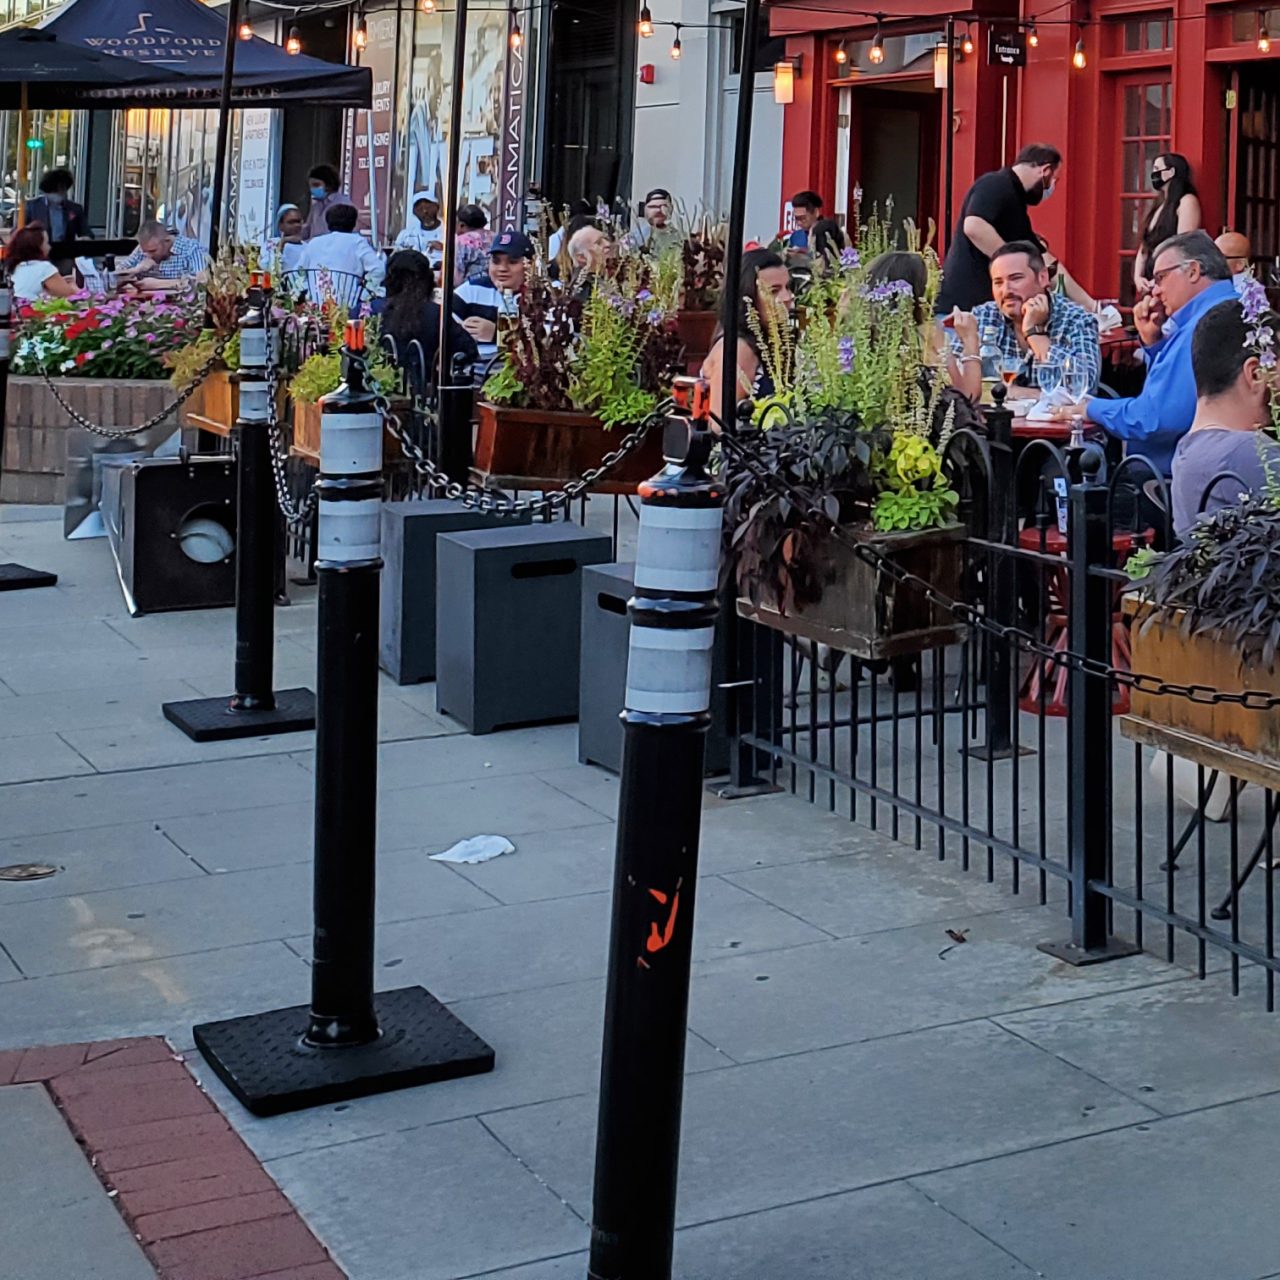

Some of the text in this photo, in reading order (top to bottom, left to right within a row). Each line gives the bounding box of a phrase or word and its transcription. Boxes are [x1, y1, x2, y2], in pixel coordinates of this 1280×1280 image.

[84, 37, 222, 48] WOODFORD
[103, 48, 216, 57] RESERVE
[995, 44, 1020, 55] Entrance
